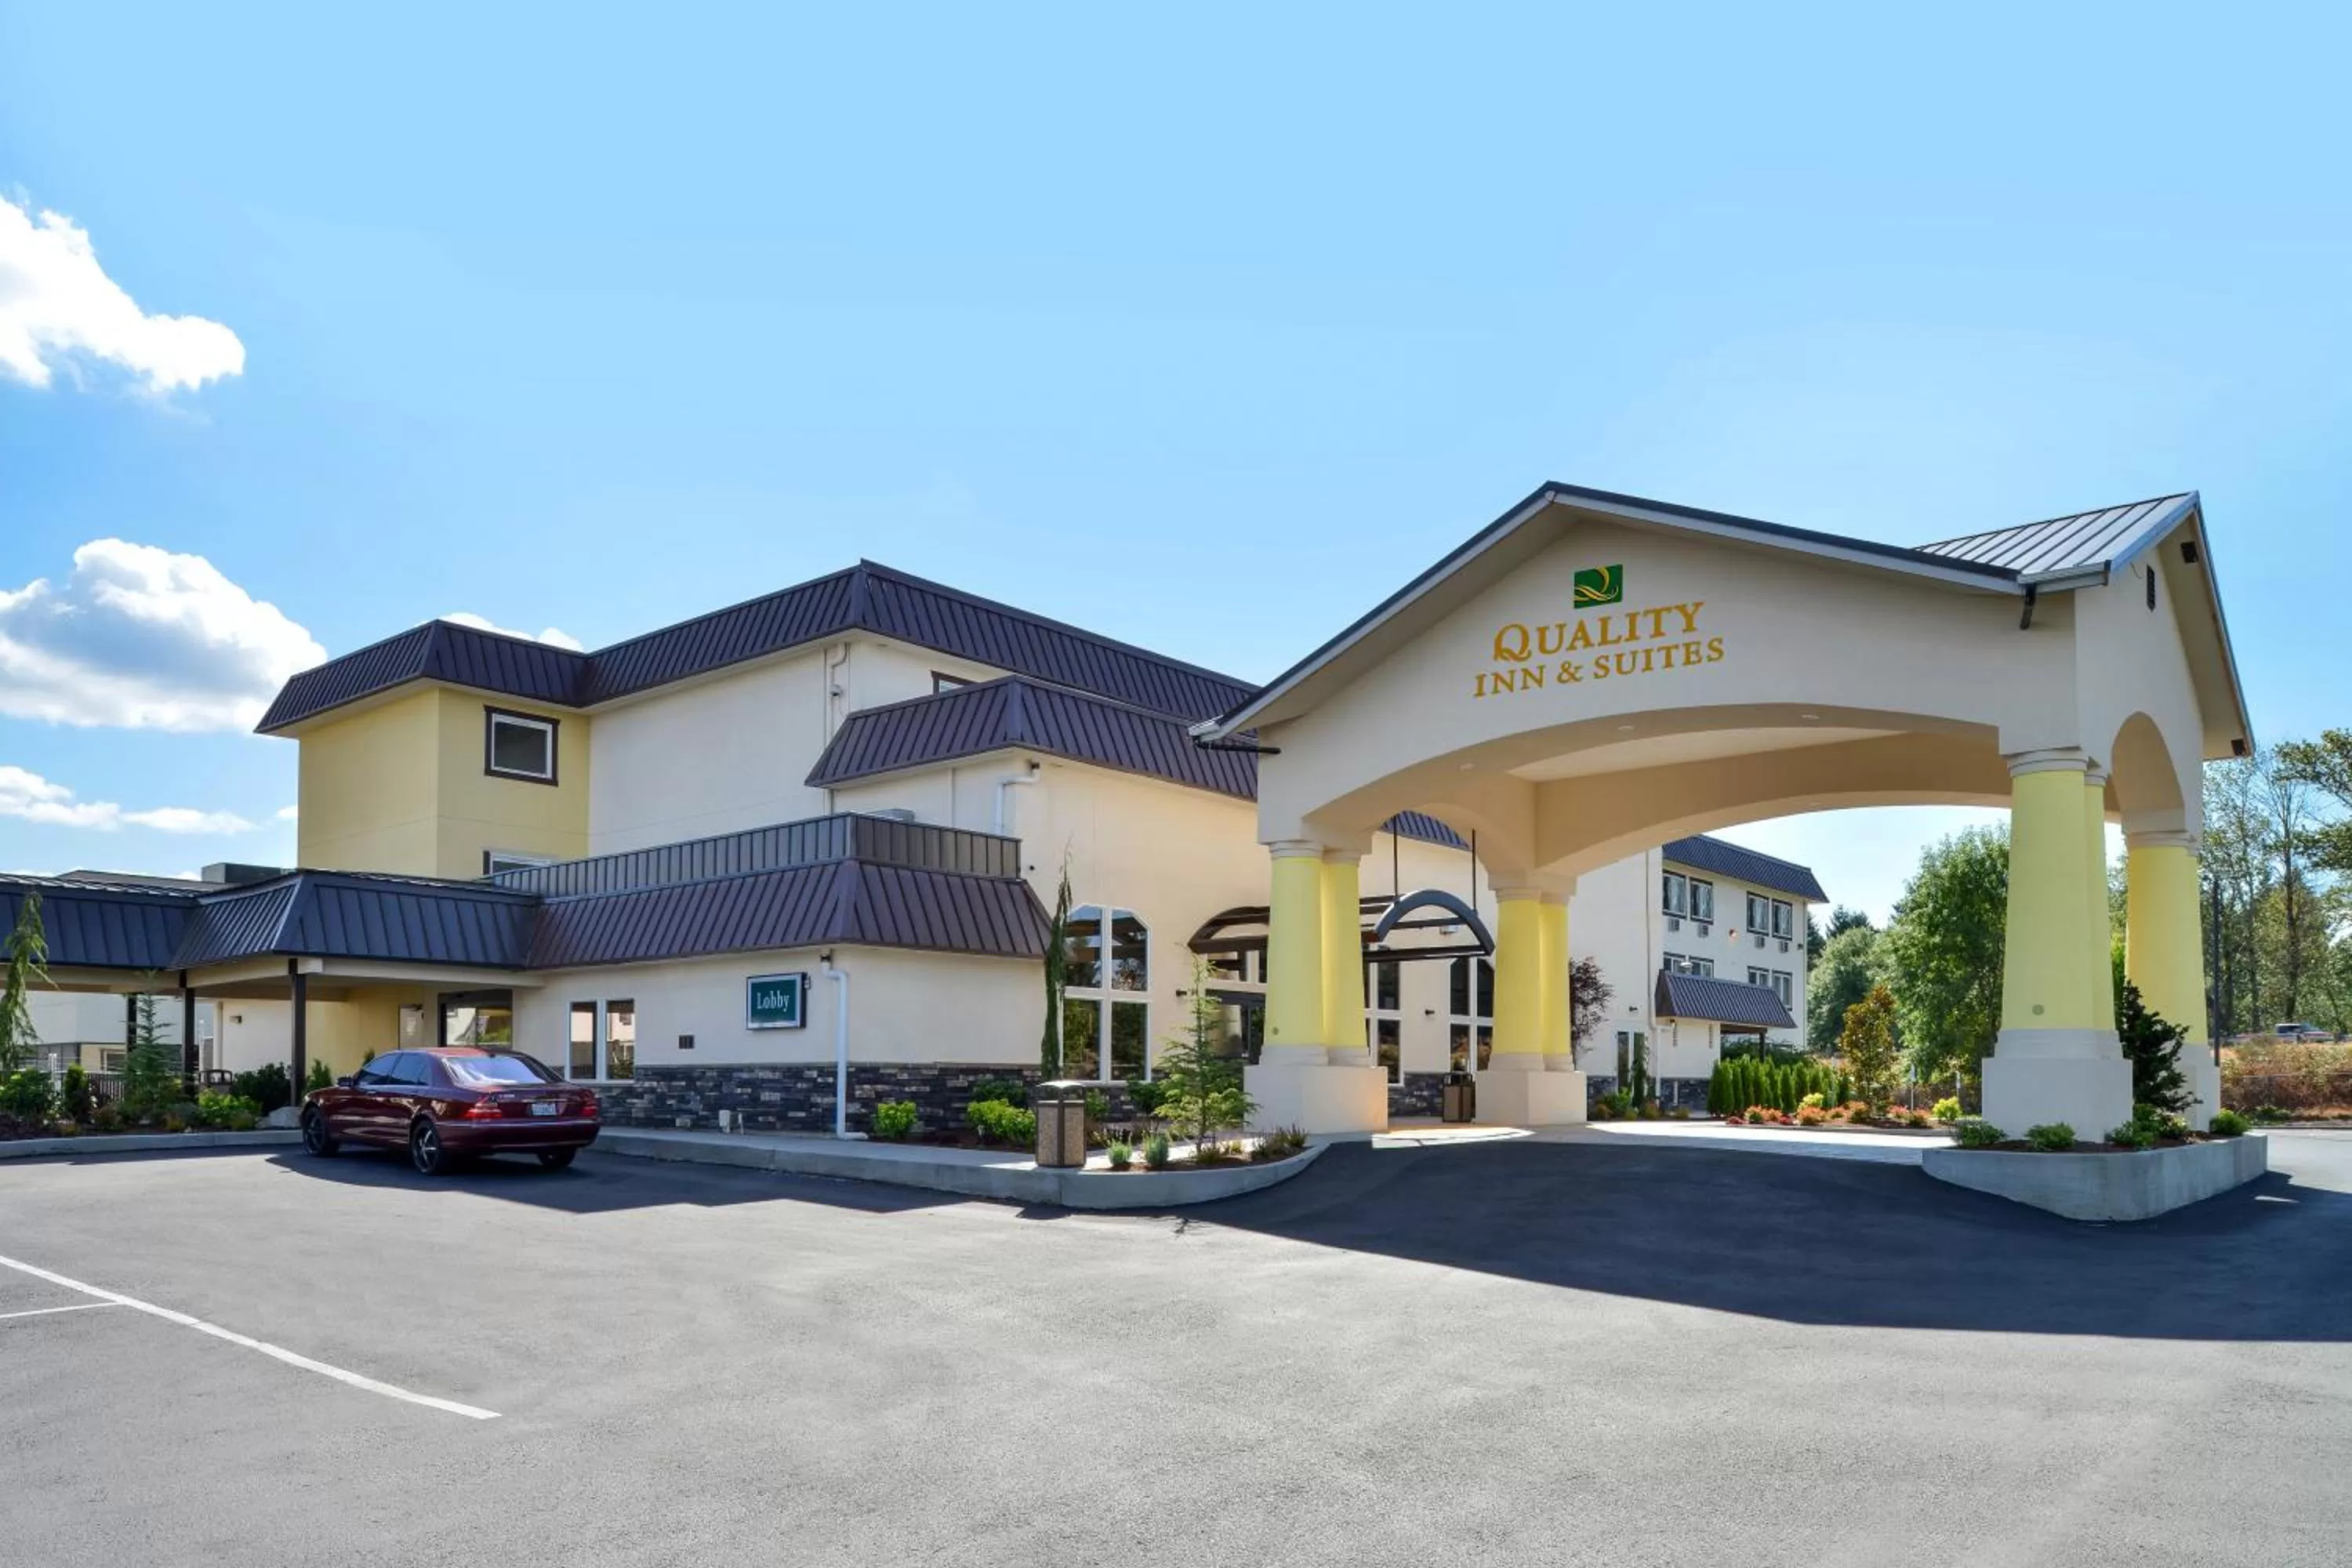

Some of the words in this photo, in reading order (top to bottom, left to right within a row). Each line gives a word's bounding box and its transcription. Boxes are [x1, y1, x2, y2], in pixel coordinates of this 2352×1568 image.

[1494, 601, 1705, 662] QUALITY
[1473, 665, 1545, 698] INN
[1556, 660, 1584, 684] &
[1592, 637, 1725, 680] SUITES
[757, 990, 790, 1013] Lobby
